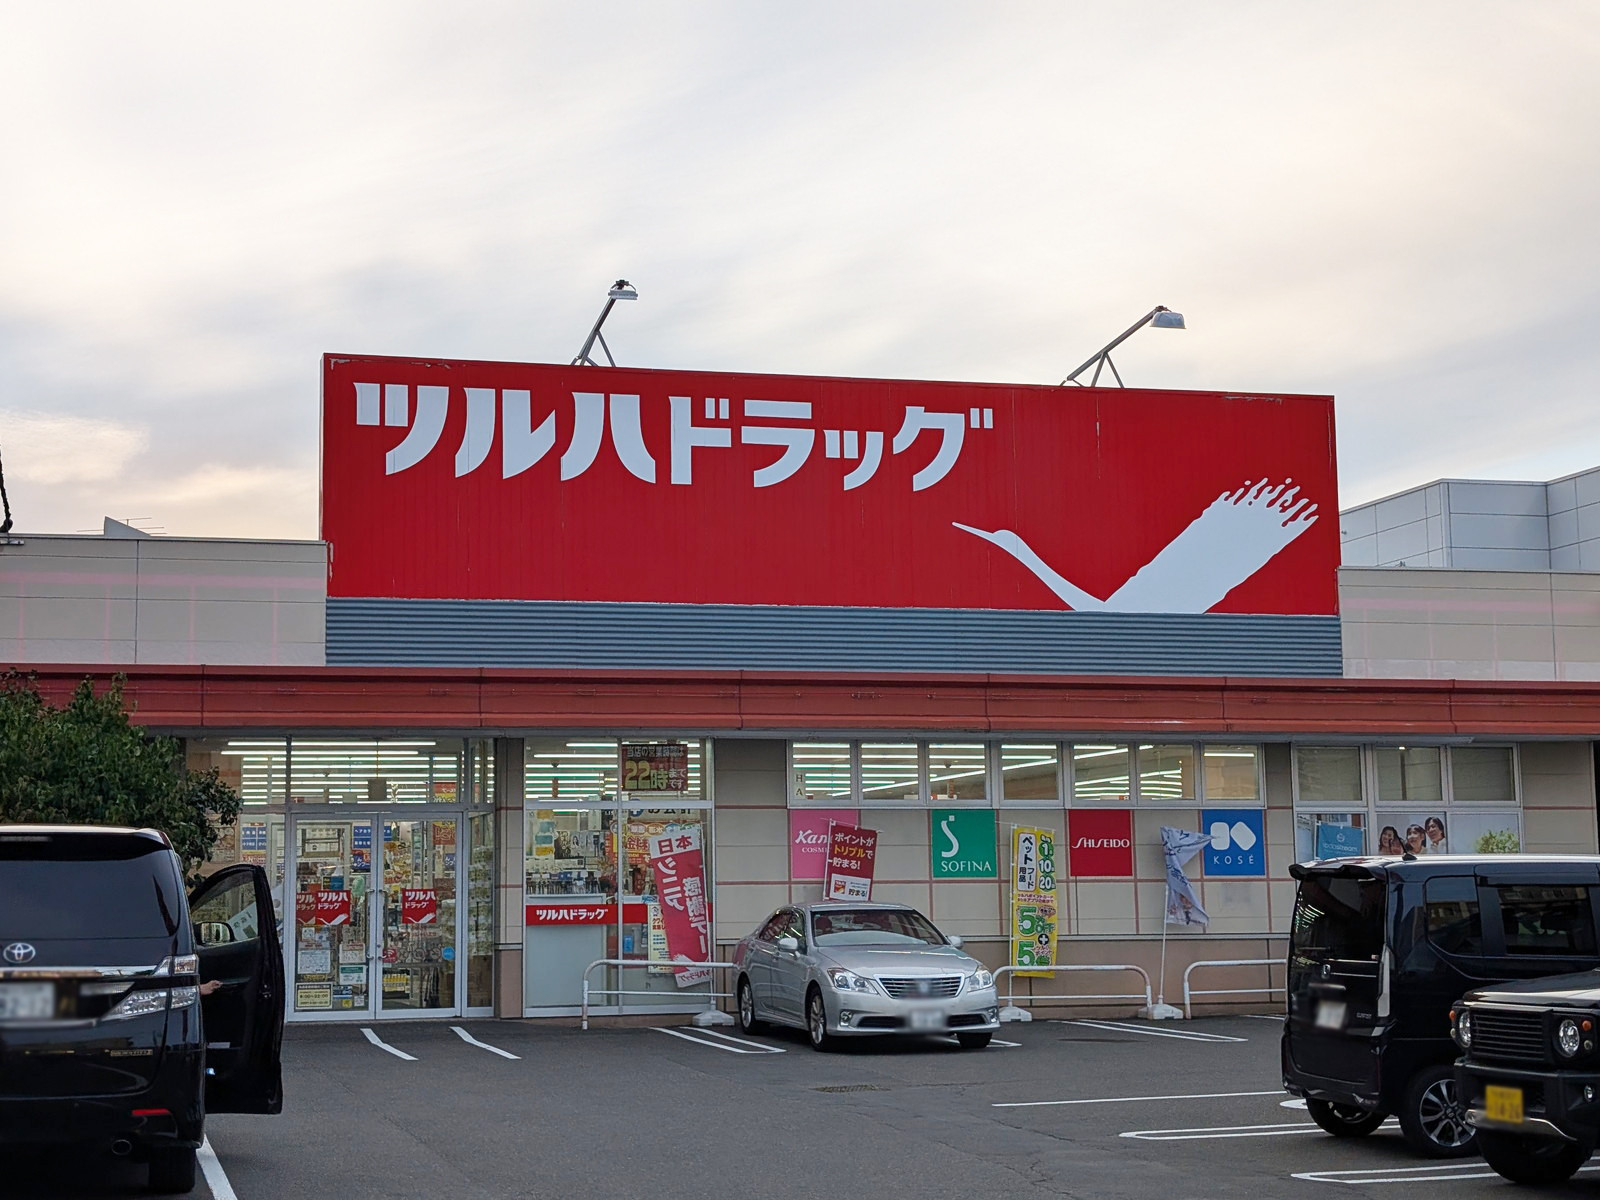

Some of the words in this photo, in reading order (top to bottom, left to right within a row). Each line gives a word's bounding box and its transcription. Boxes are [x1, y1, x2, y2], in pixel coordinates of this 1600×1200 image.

[353, 382, 993, 492] ツルハドラッグ
[625, 760, 668, 790] 22時
[668, 768, 686, 778] まで
[834, 832, 875, 847] ポイントが
[1072, 837, 1130, 849] SHISEIDO
[1022, 836, 1033, 865] ペット
[941, 860, 992, 872] SOFINA
[1213, 855, 1254, 865] KOSÉ
[1019, 866, 1027, 883] 用品
[1027, 867, 1035, 889] フード
[318, 891, 349, 902] ツルハ
[405, 890, 436, 901] ツルハ
[318, 902, 342, 910] ドラッグ
[405, 901, 430, 909] ドラッグ
[536, 908, 609, 921] ツルハドラッグ
